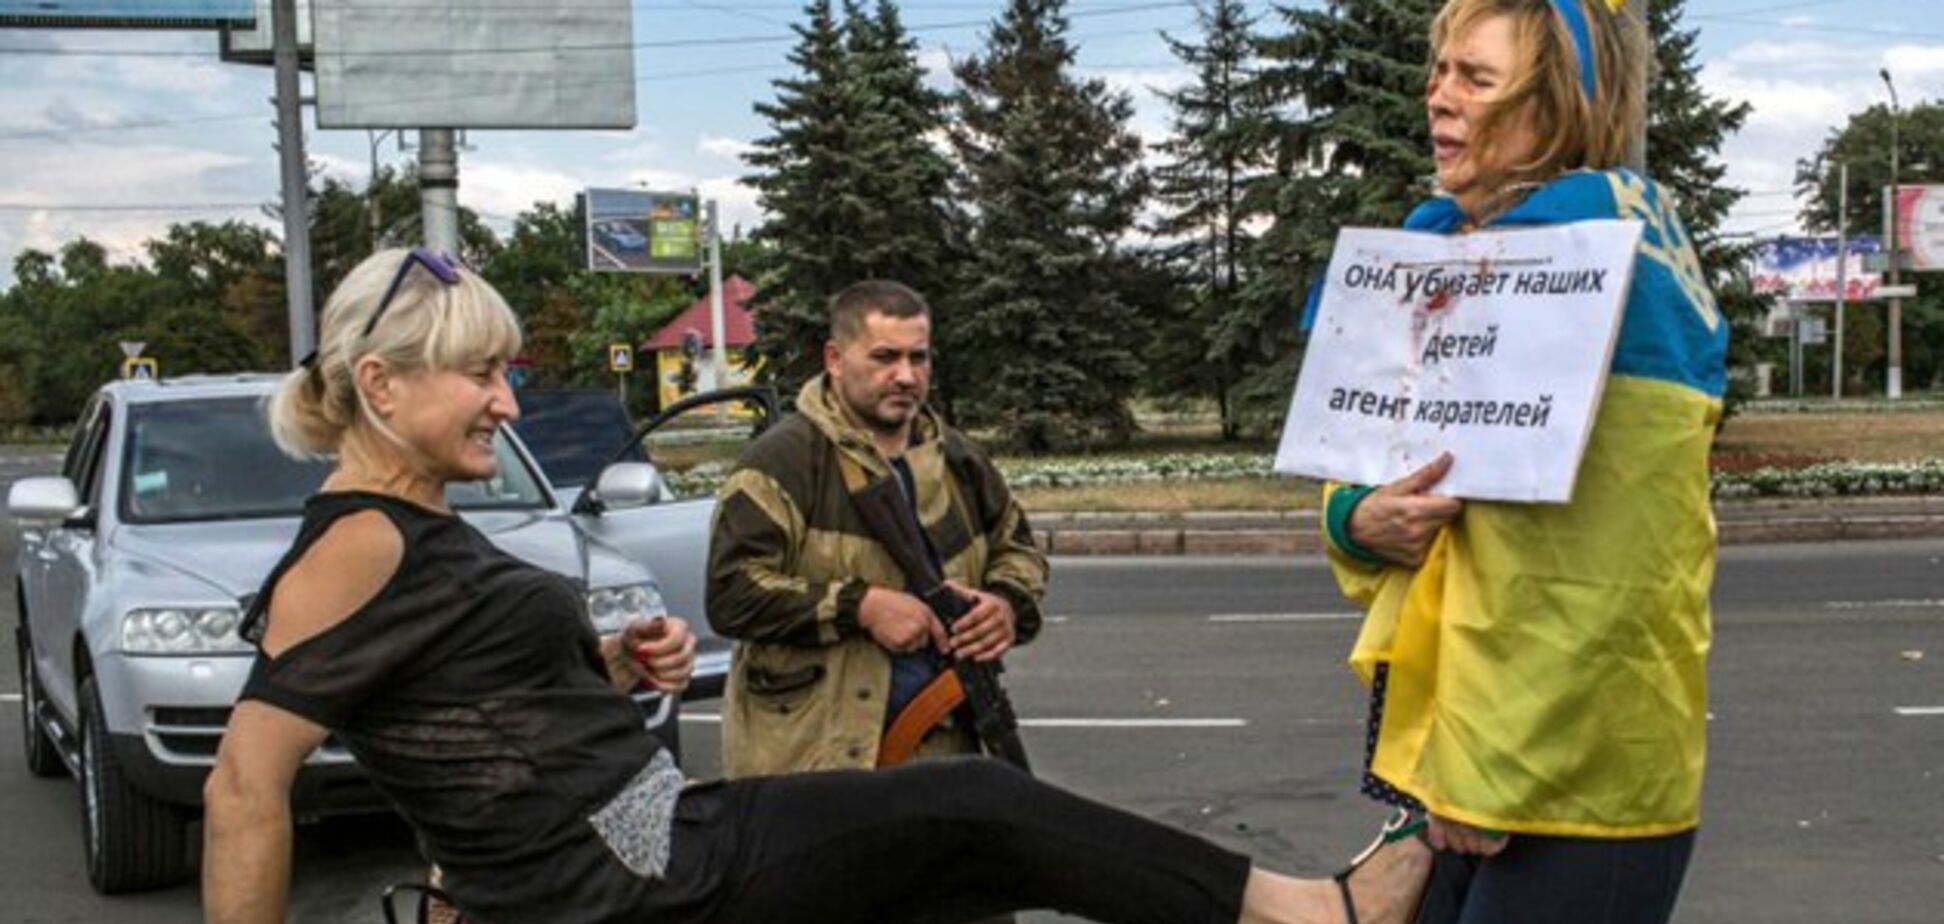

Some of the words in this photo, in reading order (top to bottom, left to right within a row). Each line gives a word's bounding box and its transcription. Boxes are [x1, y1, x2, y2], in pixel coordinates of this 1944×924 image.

[1345, 265, 1396, 290] ОНА
[1513, 268, 1607, 295] наших
[1424, 326, 1498, 364] детей
[1328, 386, 1411, 420] агент
[1414, 394, 1553, 432] карателей
